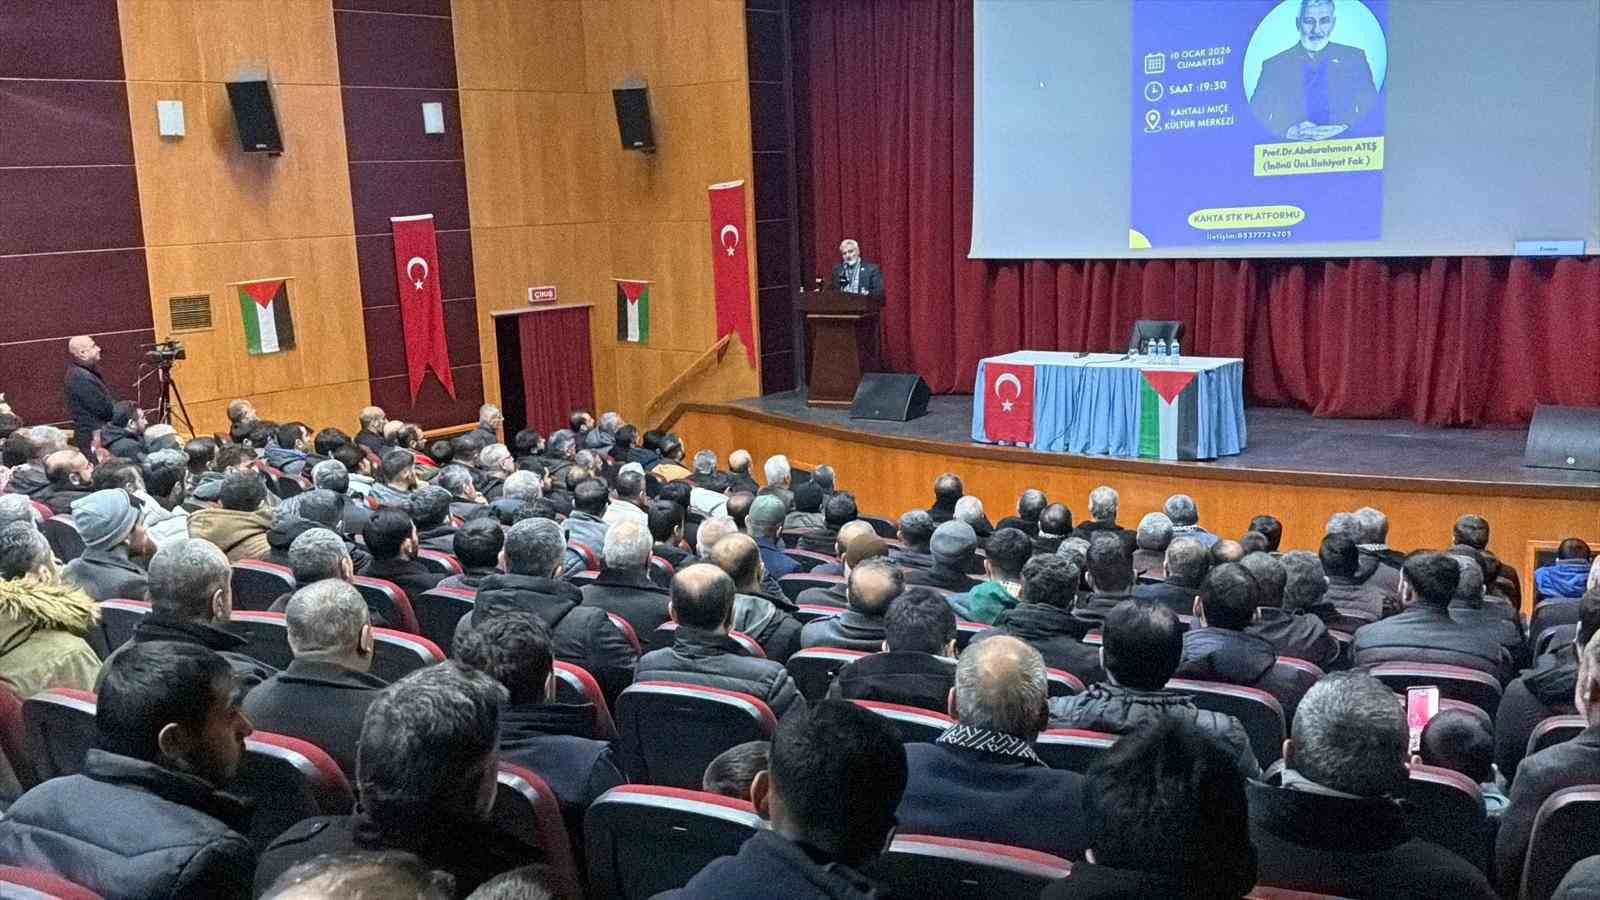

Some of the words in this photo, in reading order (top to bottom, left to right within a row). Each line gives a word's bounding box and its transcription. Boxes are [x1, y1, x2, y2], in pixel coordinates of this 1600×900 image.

[1181, 48, 1205, 57] OCAK
[1208, 46, 1231, 56] 2026
[1176, 55, 1223, 69] CUMARTESİ
[1169, 83, 1193, 95] SAAT
[1165, 118, 1195, 129] KÜLTÜR
[1198, 114, 1234, 128] MERKEZİ
[1355, 142, 1377, 152] ATEŞ
[1194, 214, 1222, 223] KAHTA
[1224, 213, 1242, 222] STK
[1244, 210, 1300, 221] PLATFORMU
[533, 289, 552, 298] ÇIKIŞ
